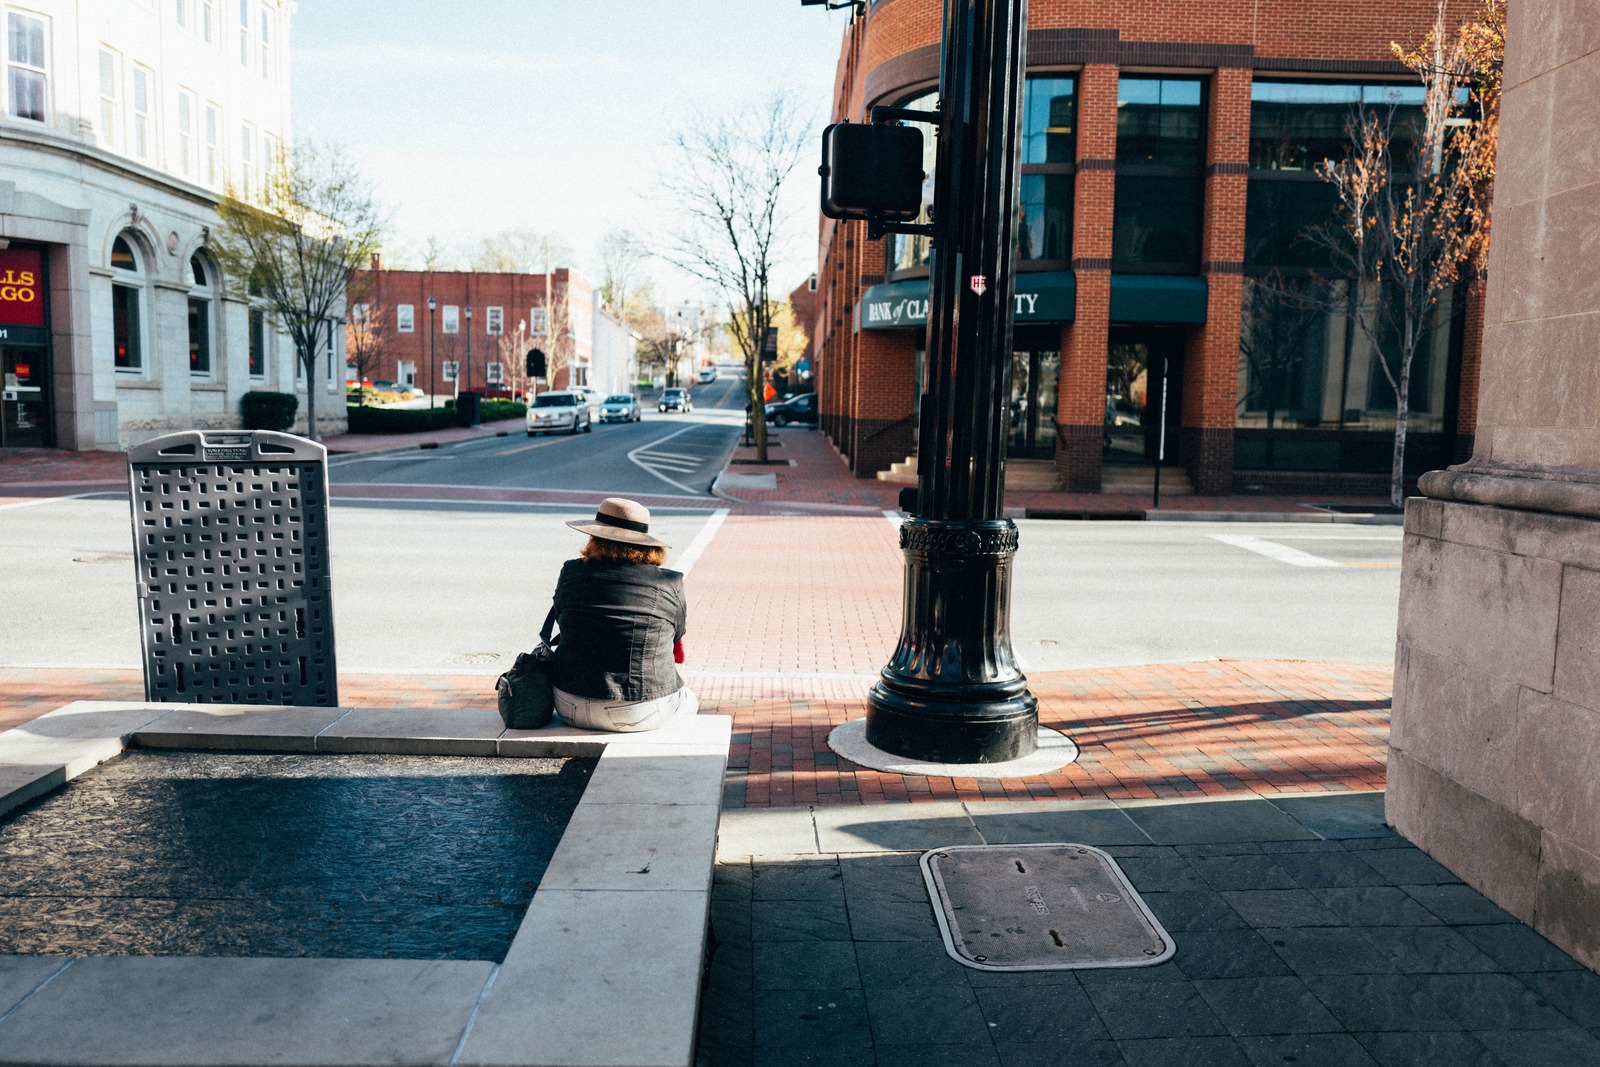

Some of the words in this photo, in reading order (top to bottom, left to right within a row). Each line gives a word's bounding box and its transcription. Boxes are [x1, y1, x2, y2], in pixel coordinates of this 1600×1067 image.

[0, 286, 35, 302] GO
[869, 302, 892, 321] BANK
[892, 298, 908, 325] of
[1014, 293, 1039, 314] TY
